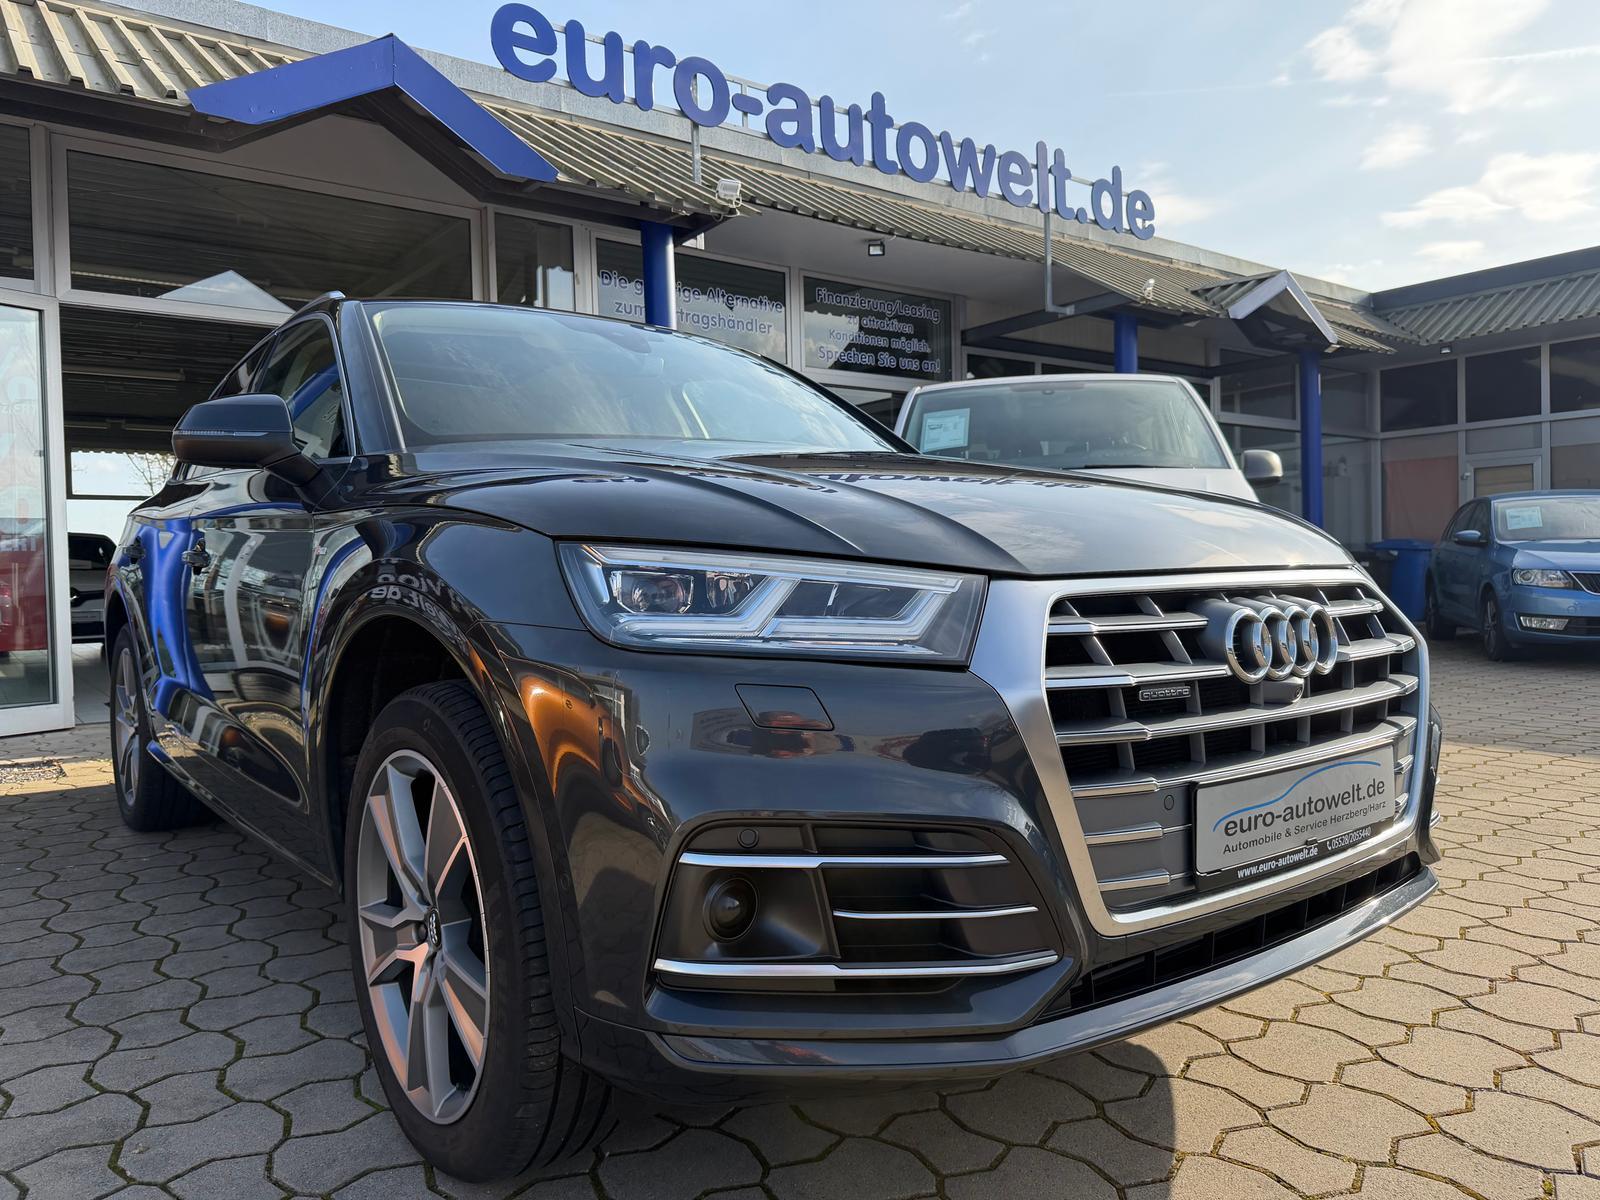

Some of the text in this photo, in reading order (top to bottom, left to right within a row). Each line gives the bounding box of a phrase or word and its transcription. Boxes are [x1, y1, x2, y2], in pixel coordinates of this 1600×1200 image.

[490, 3, 1155, 240] euro-autowelt.de
[600, 270, 783, 314] Die gige Alternative
[815, 287, 940, 325] Finanzierung/Leasing
[676, 307, 773, 335] tragshändler
[847, 314, 914, 334] zu attraktiven
[828, 328, 931, 353] Konditionen möglich.
[818, 345, 940, 374] Sprechen Sie uns an!
[1142, 688, 1190, 701] quattro
[1223, 778, 1386, 837] euro-autowelt.de
[1222, 801, 1387, 855] Automobile & Service Herzberg/Harz
[1237, 845, 1319, 879] www.euro-autowelt.de
